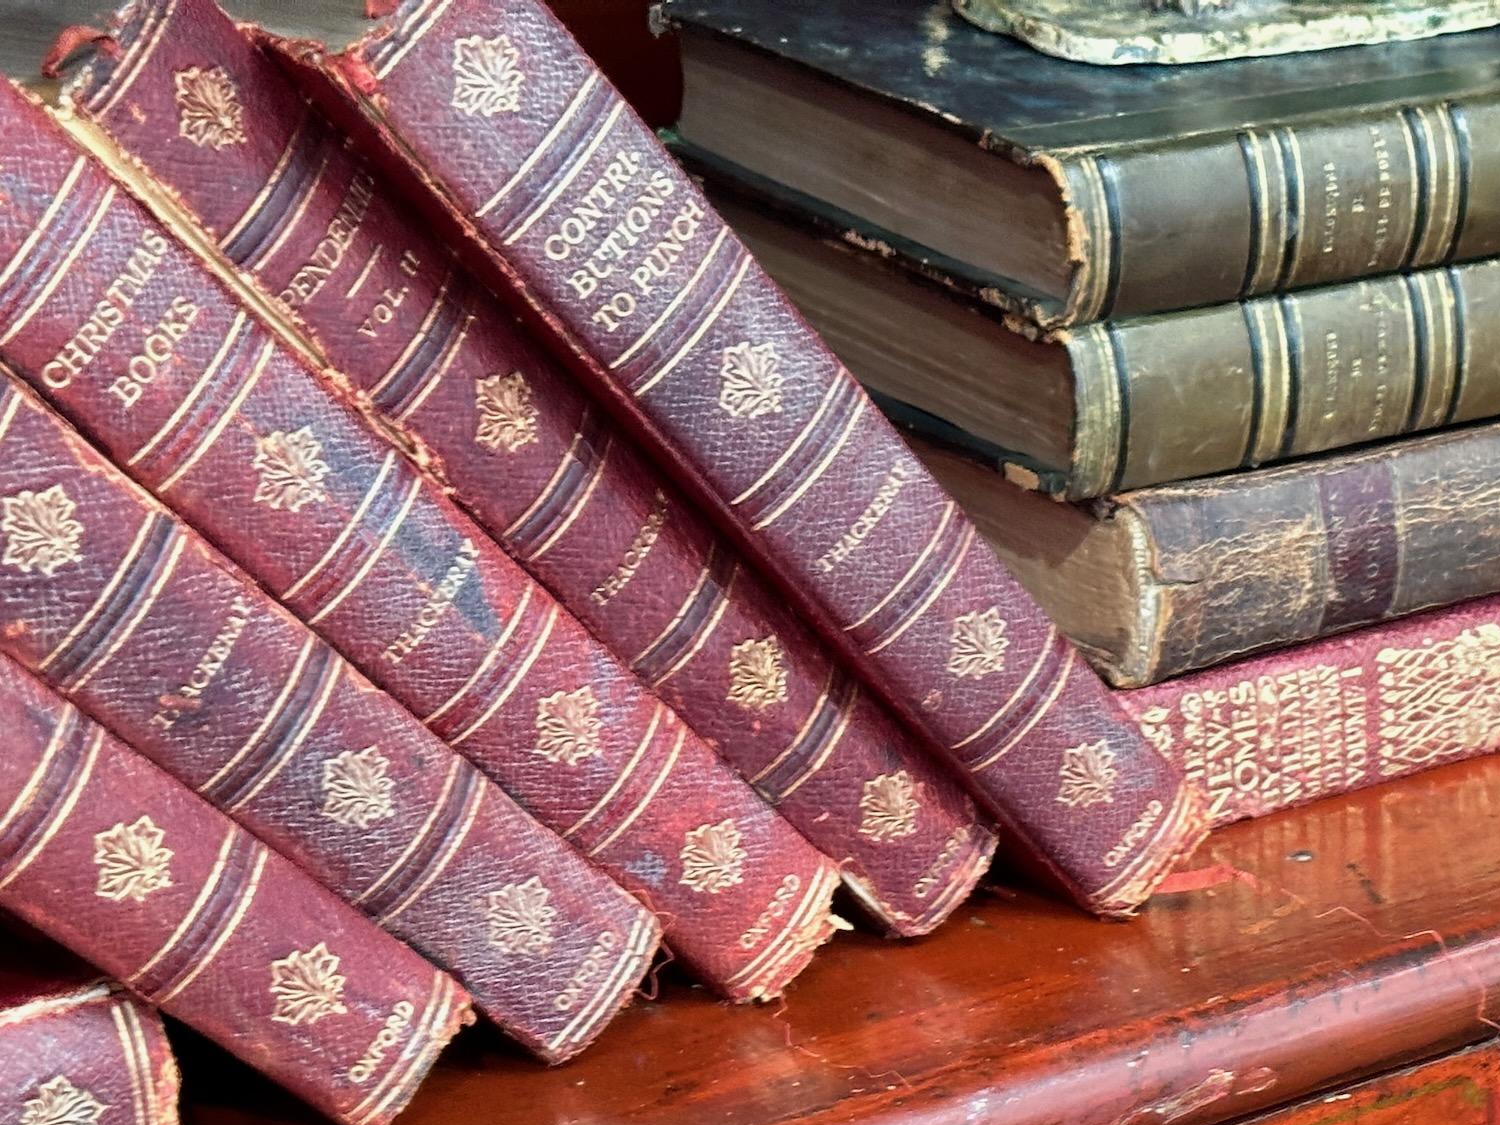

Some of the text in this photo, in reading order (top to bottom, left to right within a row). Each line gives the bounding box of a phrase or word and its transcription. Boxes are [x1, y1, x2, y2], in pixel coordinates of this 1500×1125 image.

[277, 172, 376, 304] PENDENNI
[543, 150, 641, 261] CONTRI-
[567, 170, 674, 300] BUTIONS
[41, 228, 169, 389] CHRISTMAS
[357, 286, 410, 338] VOL.
[592, 198, 705, 333] TO PUNCH
[107, 295, 198, 409] BOOKS
[588, 486, 670, 607] THACKERAY
[813, 458, 910, 574] THACKERAY
[380, 537, 481, 664] THACKERAY
[1276, 673, 1303, 806] WILLIAM
[1343, 685, 1367, 787] VOLUME
[912, 824, 973, 899] OXFORD
[1103, 799, 1163, 869] OXFORD
[738, 874, 802, 950] OXFORD
[552, 930, 616, 1012] OXFORD
[348, 1000, 415, 1084] OXFORD
